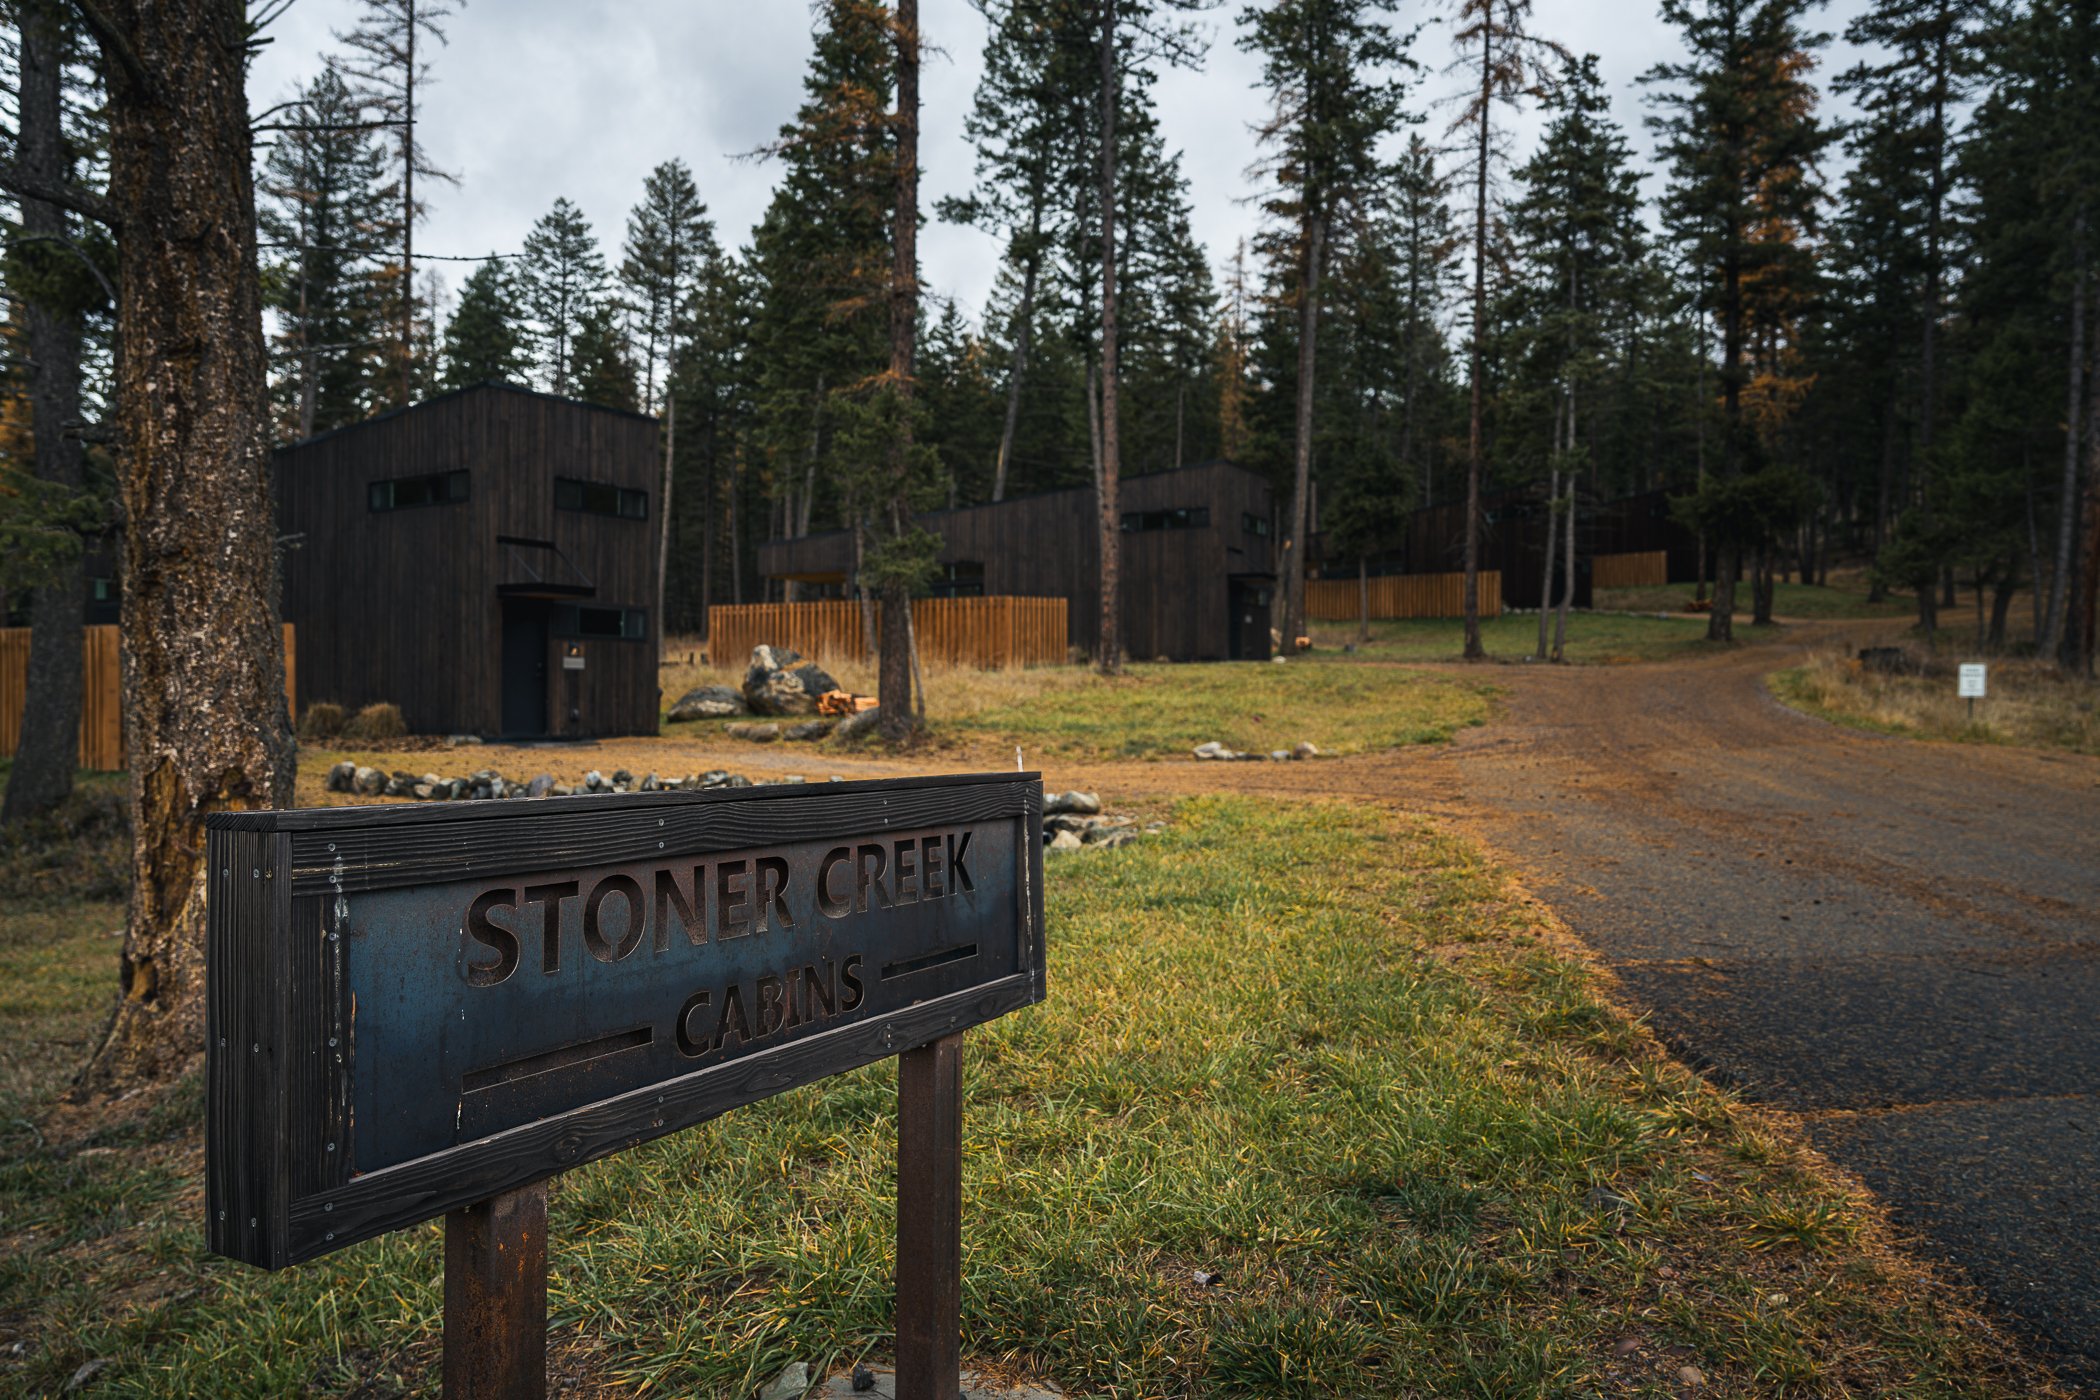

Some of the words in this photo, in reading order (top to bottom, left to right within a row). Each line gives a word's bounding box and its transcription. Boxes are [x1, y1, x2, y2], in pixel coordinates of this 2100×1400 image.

[465, 855, 795, 988] STONER
[817, 831, 976, 919] CREEK
[675, 955, 865, 1058] CABINS
